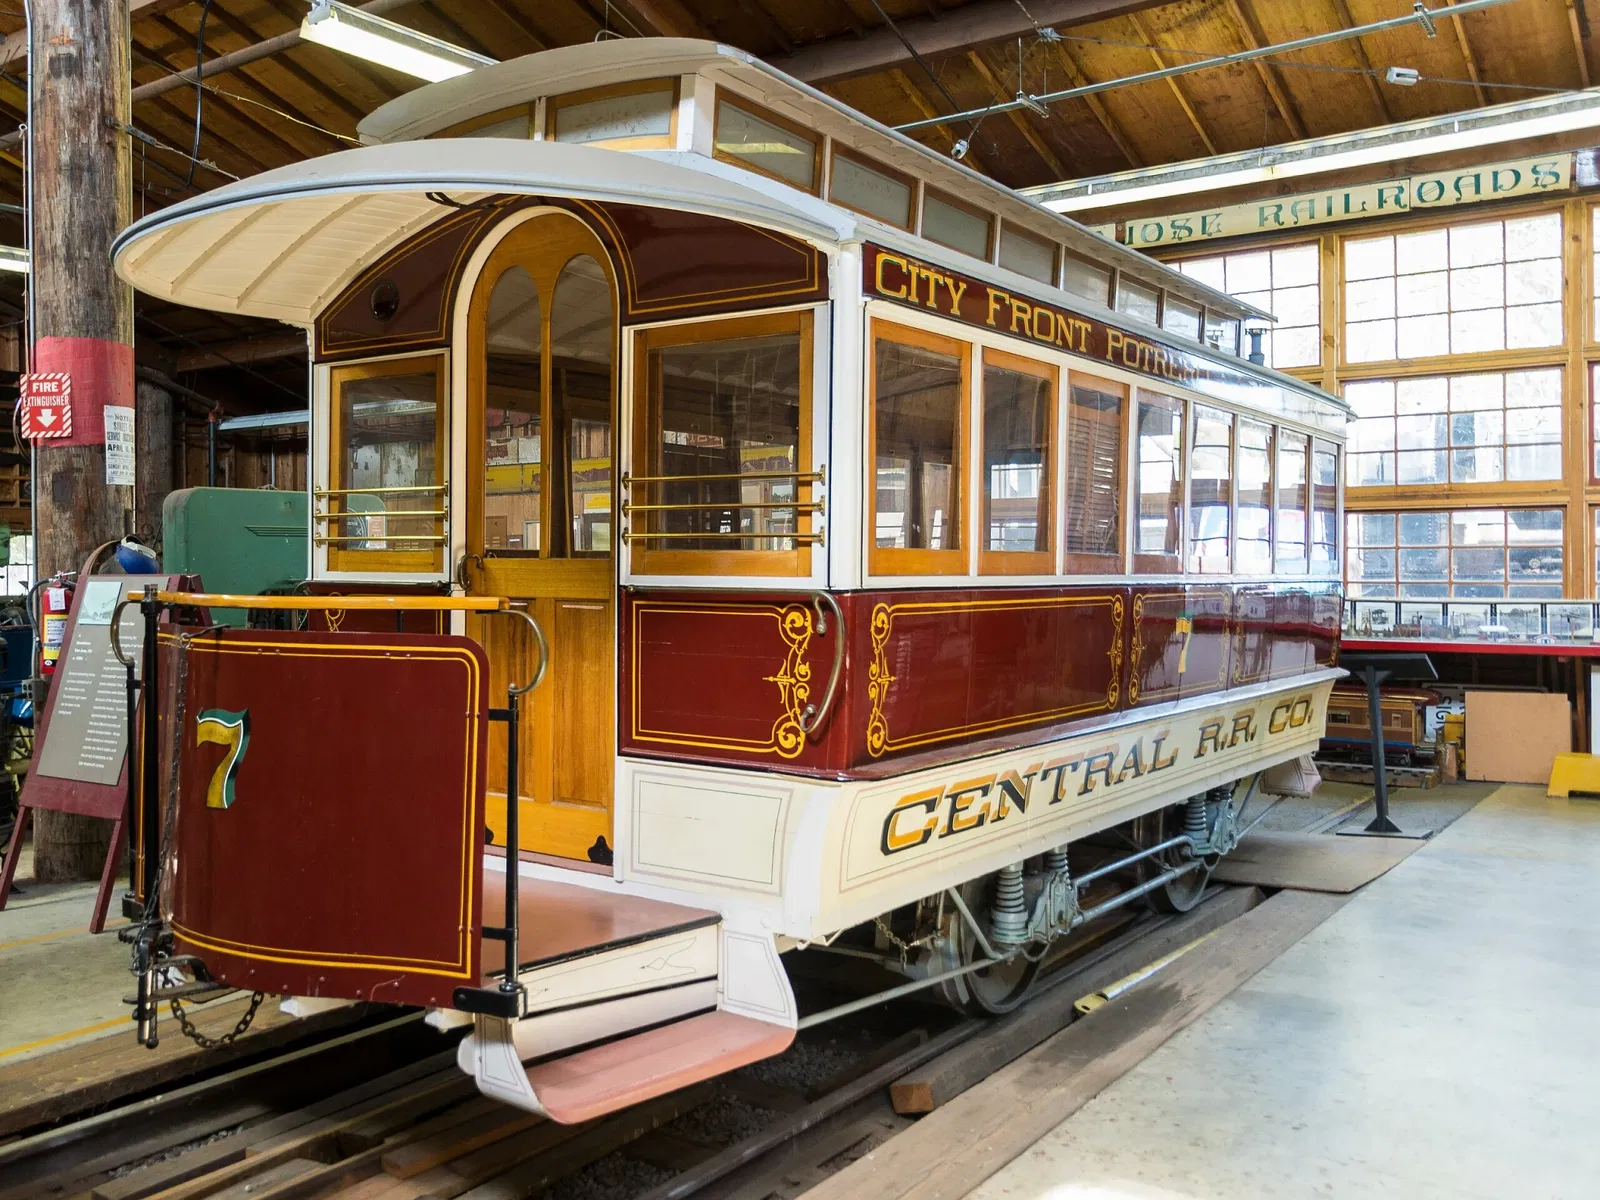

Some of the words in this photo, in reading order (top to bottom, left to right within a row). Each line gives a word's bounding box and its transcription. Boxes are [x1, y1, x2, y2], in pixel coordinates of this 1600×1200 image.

[1257, 162, 1561, 228] RAILROADS
[875, 252, 967, 317] CITY
[986, 287, 1092, 353] FRONT
[23, 395, 69, 407] EXTINGUISHER
[32, 381, 59, 393] FIRE
[1175, 610, 1194, 674] 7
[196, 706, 252, 810] 7
[880, 729, 1180, 857] CENTRAL
[1268, 693, 1314, 735] CO.
